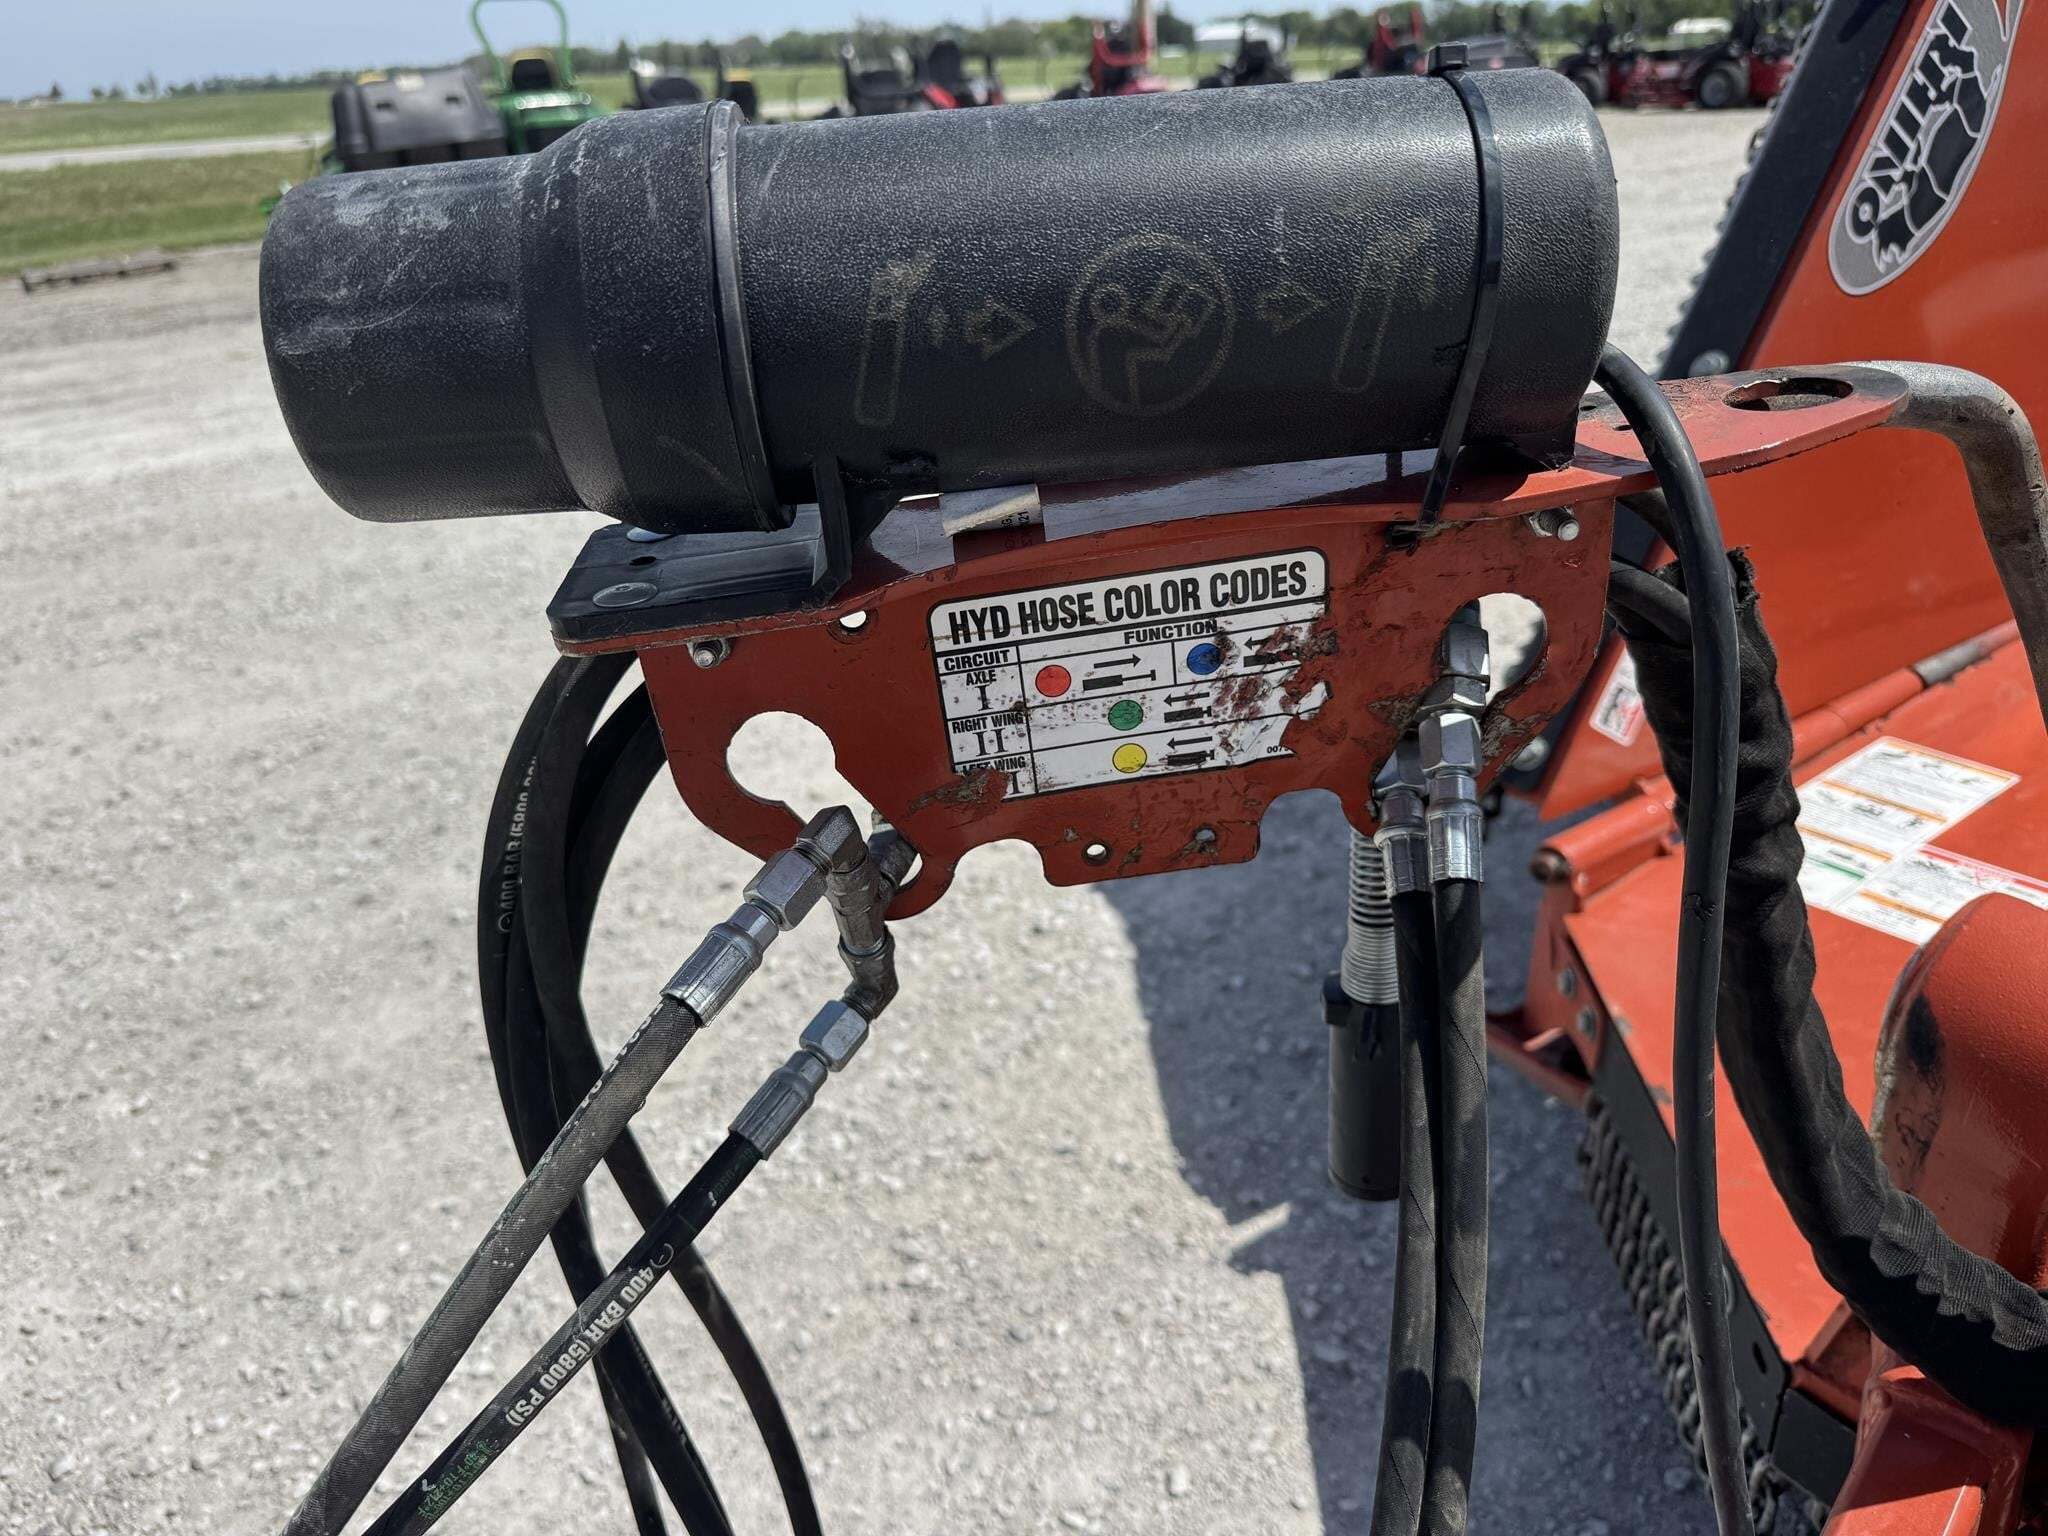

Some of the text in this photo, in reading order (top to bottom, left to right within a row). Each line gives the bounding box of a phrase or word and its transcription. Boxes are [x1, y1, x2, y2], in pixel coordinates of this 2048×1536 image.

[948, 561, 1307, 645] HYD HOSE COLOR CODES
[1124, 619, 1218, 644] FUNCTION
[944, 649, 1010, 671] CIRCUIT
[966, 669, 997, 686] AXLE
[952, 711, 1025, 734] RIGHT WING
[994, 756, 1027, 771] WING
[506, 1266, 654, 1428] 400 BAR (5800 PSI)
